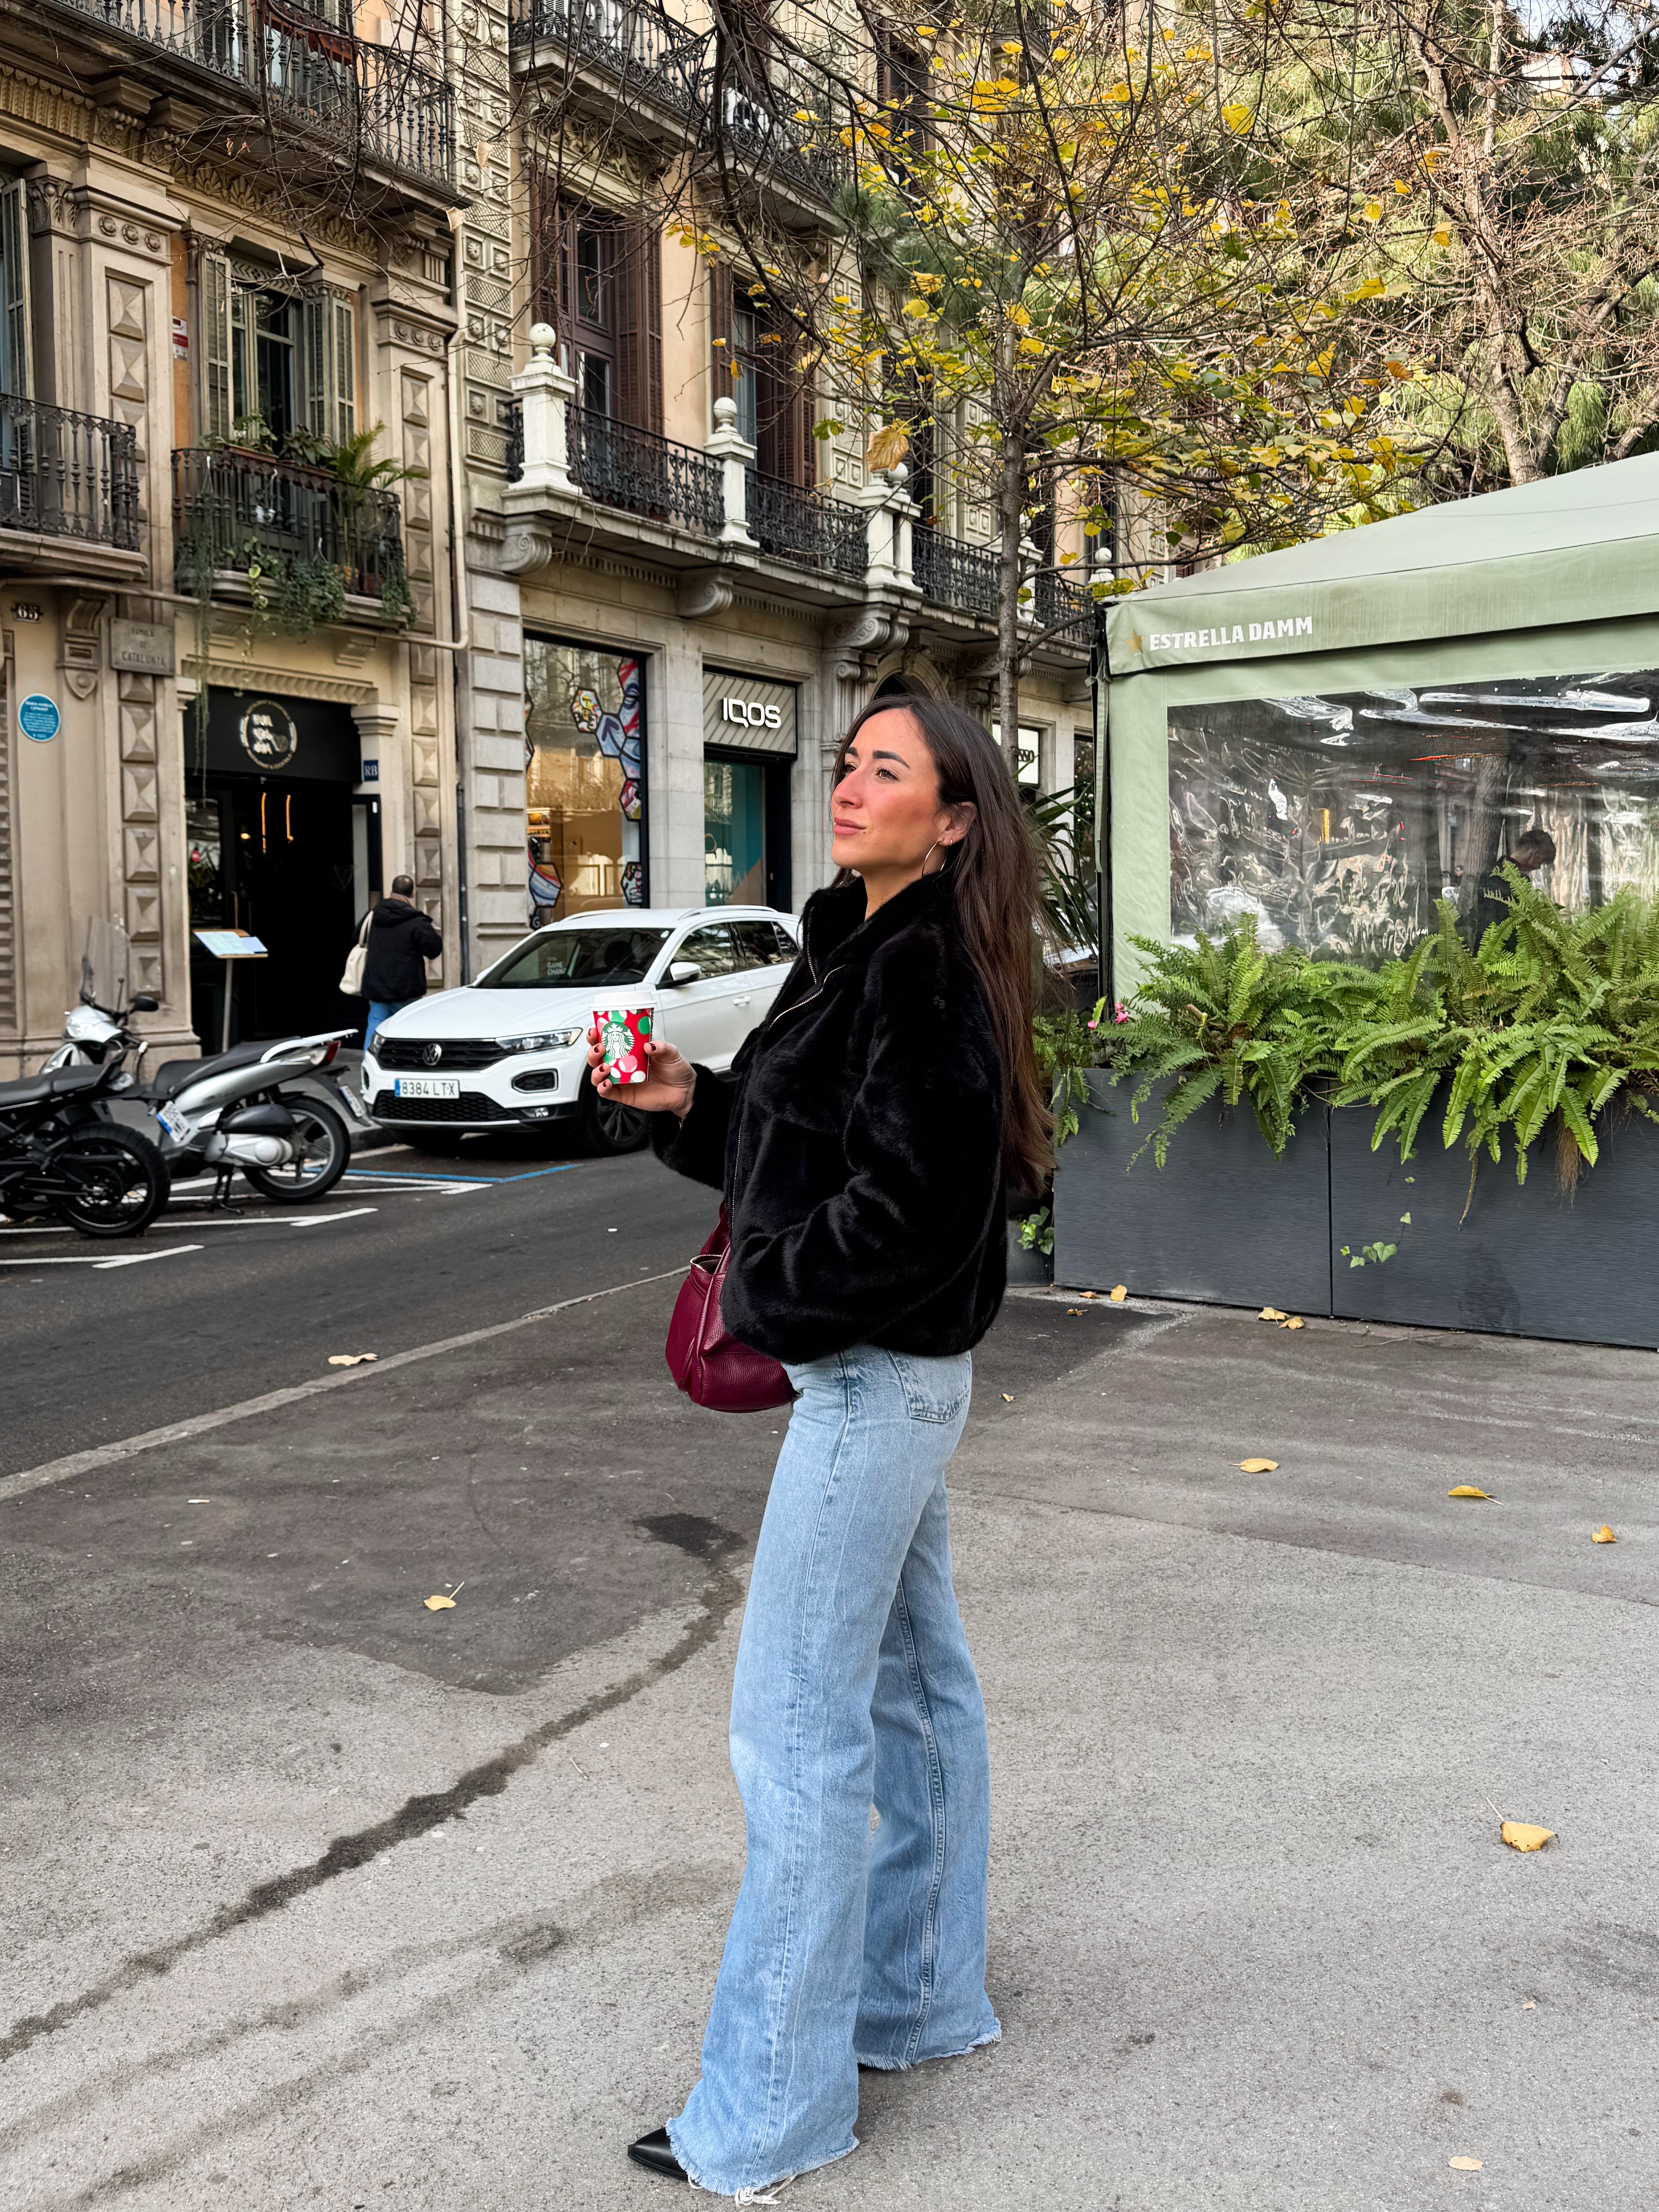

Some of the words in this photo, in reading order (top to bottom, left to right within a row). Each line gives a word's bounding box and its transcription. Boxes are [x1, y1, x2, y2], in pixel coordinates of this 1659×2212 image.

[1150, 624, 1244, 651] ESTRELLA
[1248, 616, 1313, 642] DAMM
[723, 697, 781, 729] IQOS
[365, 765, 378, 777] RB
[402, 1081, 429, 1095] 8384
[433, 1082, 455, 1096] LTX
